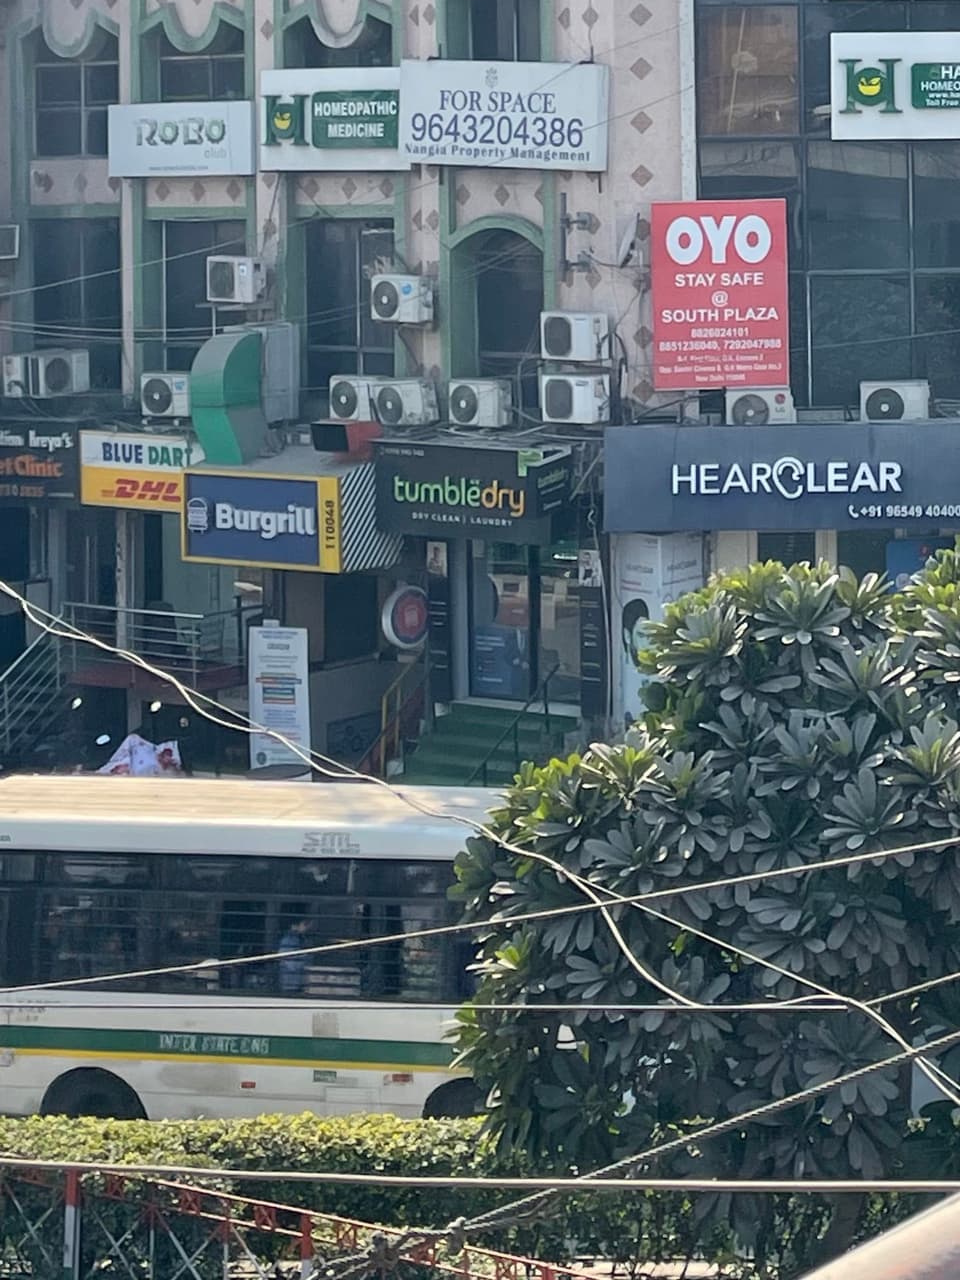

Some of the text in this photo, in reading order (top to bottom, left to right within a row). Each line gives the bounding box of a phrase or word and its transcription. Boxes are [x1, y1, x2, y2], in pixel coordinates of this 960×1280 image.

[314, 100, 398, 117] HOMEOPATHIC
[439, 90, 557, 114] FOR SPACE
[327, 123, 384, 138] MEDICINE
[411, 113, 584, 148] 9643204386
[405, 143, 591, 162] Nangia Property Management
[665, 214, 772, 265] OYO
[674, 272, 764, 287] STAY SAFE
[711, 291, 728, 307] @
[661, 307, 779, 323] SOUTH PLAZA
[102, 442, 193, 467] BLUE DART
[112, 478, 182, 502] DHL
[412, 512, 513, 527] DRY CLEAN LAUNDRY
[860, 505, 882, 517] +91
[215, 503, 317, 539] Burgrill
